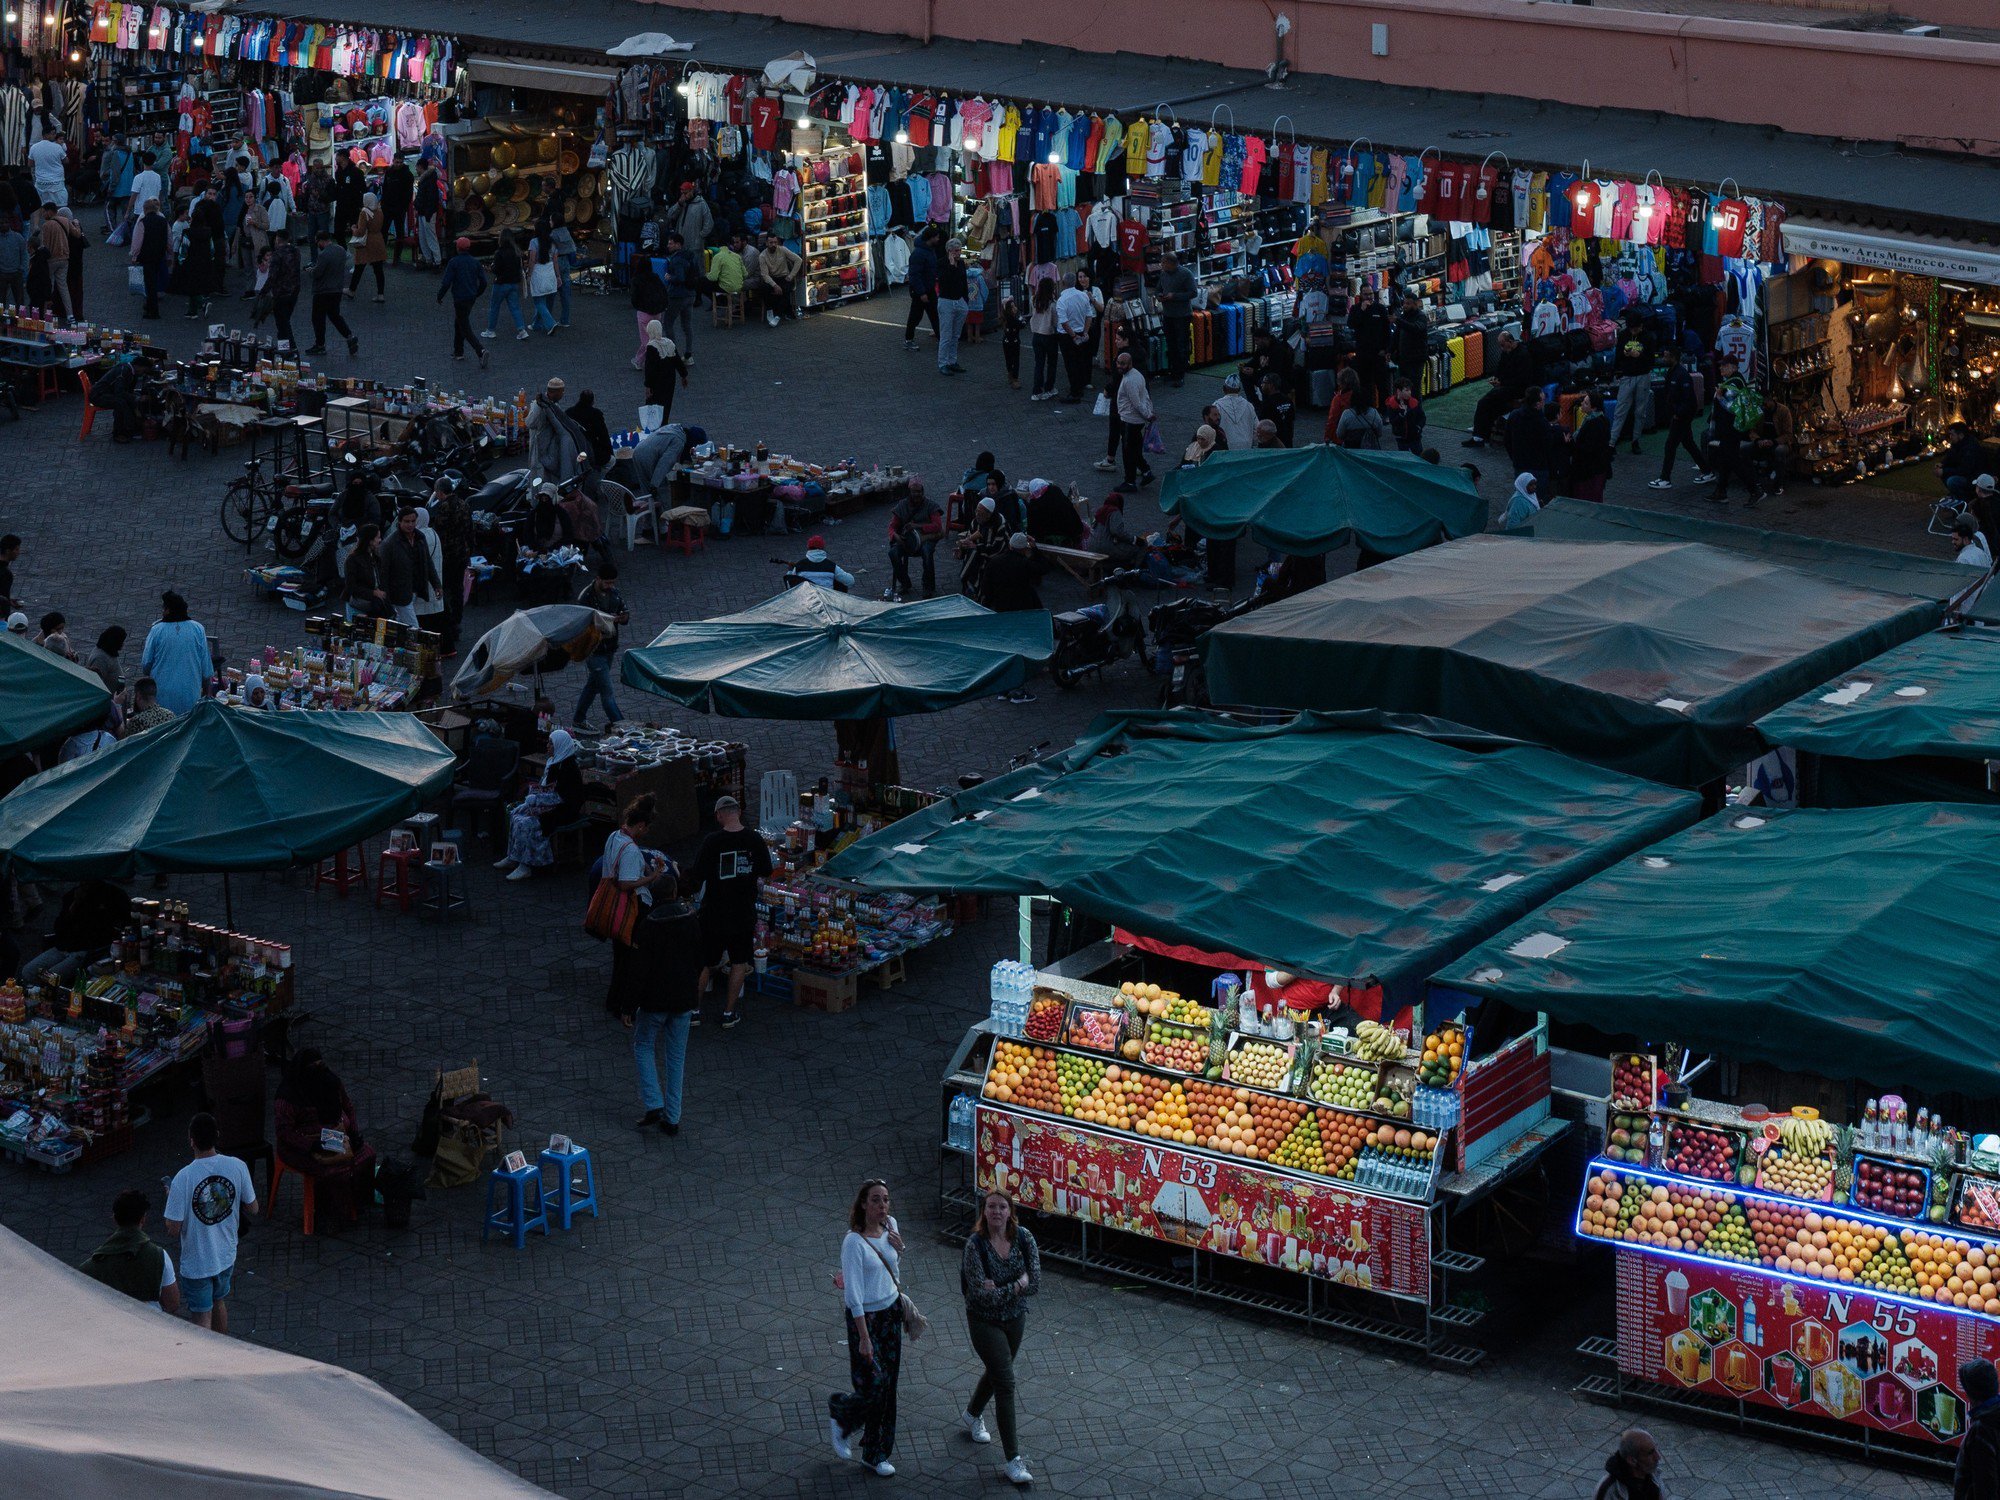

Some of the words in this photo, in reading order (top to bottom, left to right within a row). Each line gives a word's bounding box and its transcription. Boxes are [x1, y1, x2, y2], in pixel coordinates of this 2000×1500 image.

[760, 110, 769, 128] 7
[1131, 137, 1138, 154] 9
[1185, 143, 1199, 162] 10
[1440, 177, 1453, 199] 10
[1723, 212, 1739, 232] 10
[1127, 235, 1135, 253] 2
[1820, 243, 1978, 273] www.ArtsMorocco.com
[1140, 1146, 1165, 1179] N
[1179, 1155, 1219, 1190] 53
[1822, 1290, 1855, 1325] N
[1870, 1299, 1920, 1338] 55
